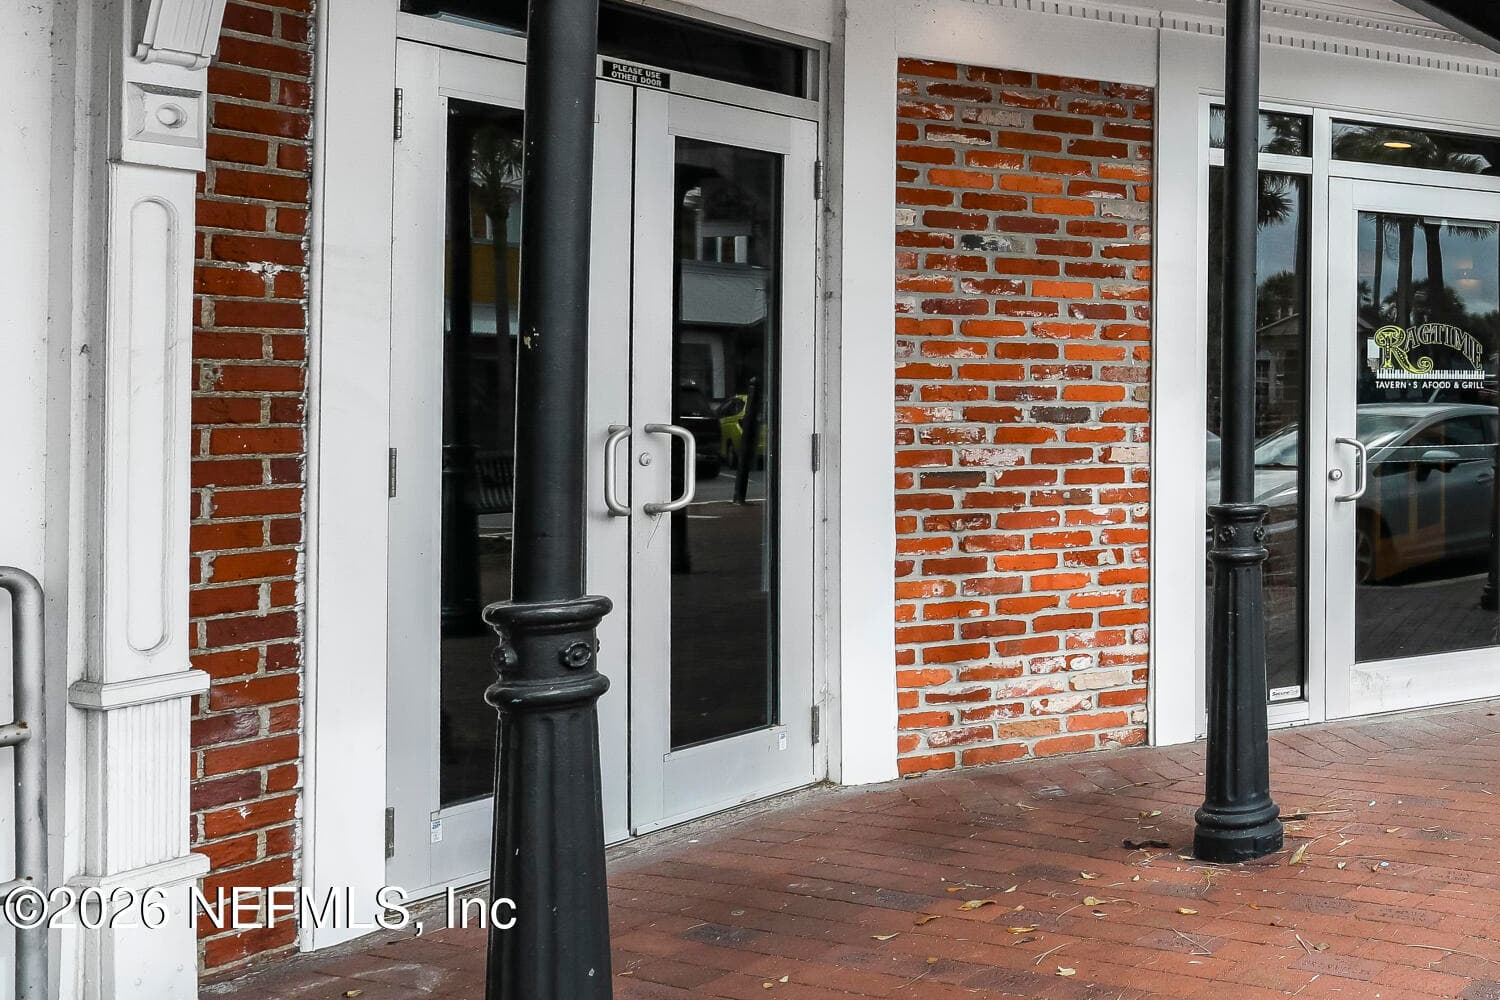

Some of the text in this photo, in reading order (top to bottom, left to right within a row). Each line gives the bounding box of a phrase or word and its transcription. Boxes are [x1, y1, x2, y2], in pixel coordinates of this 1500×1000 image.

[611, 70, 662, 87] OTHER DOOR
[612, 63, 661, 80] PLEASE USE
[1373, 322, 1484, 374] RAGTIME
[1375, 380, 1407, 389] TAVERN
[1453, 381, 1460, 389] &
[1461, 380, 1485, 389] GRILL
